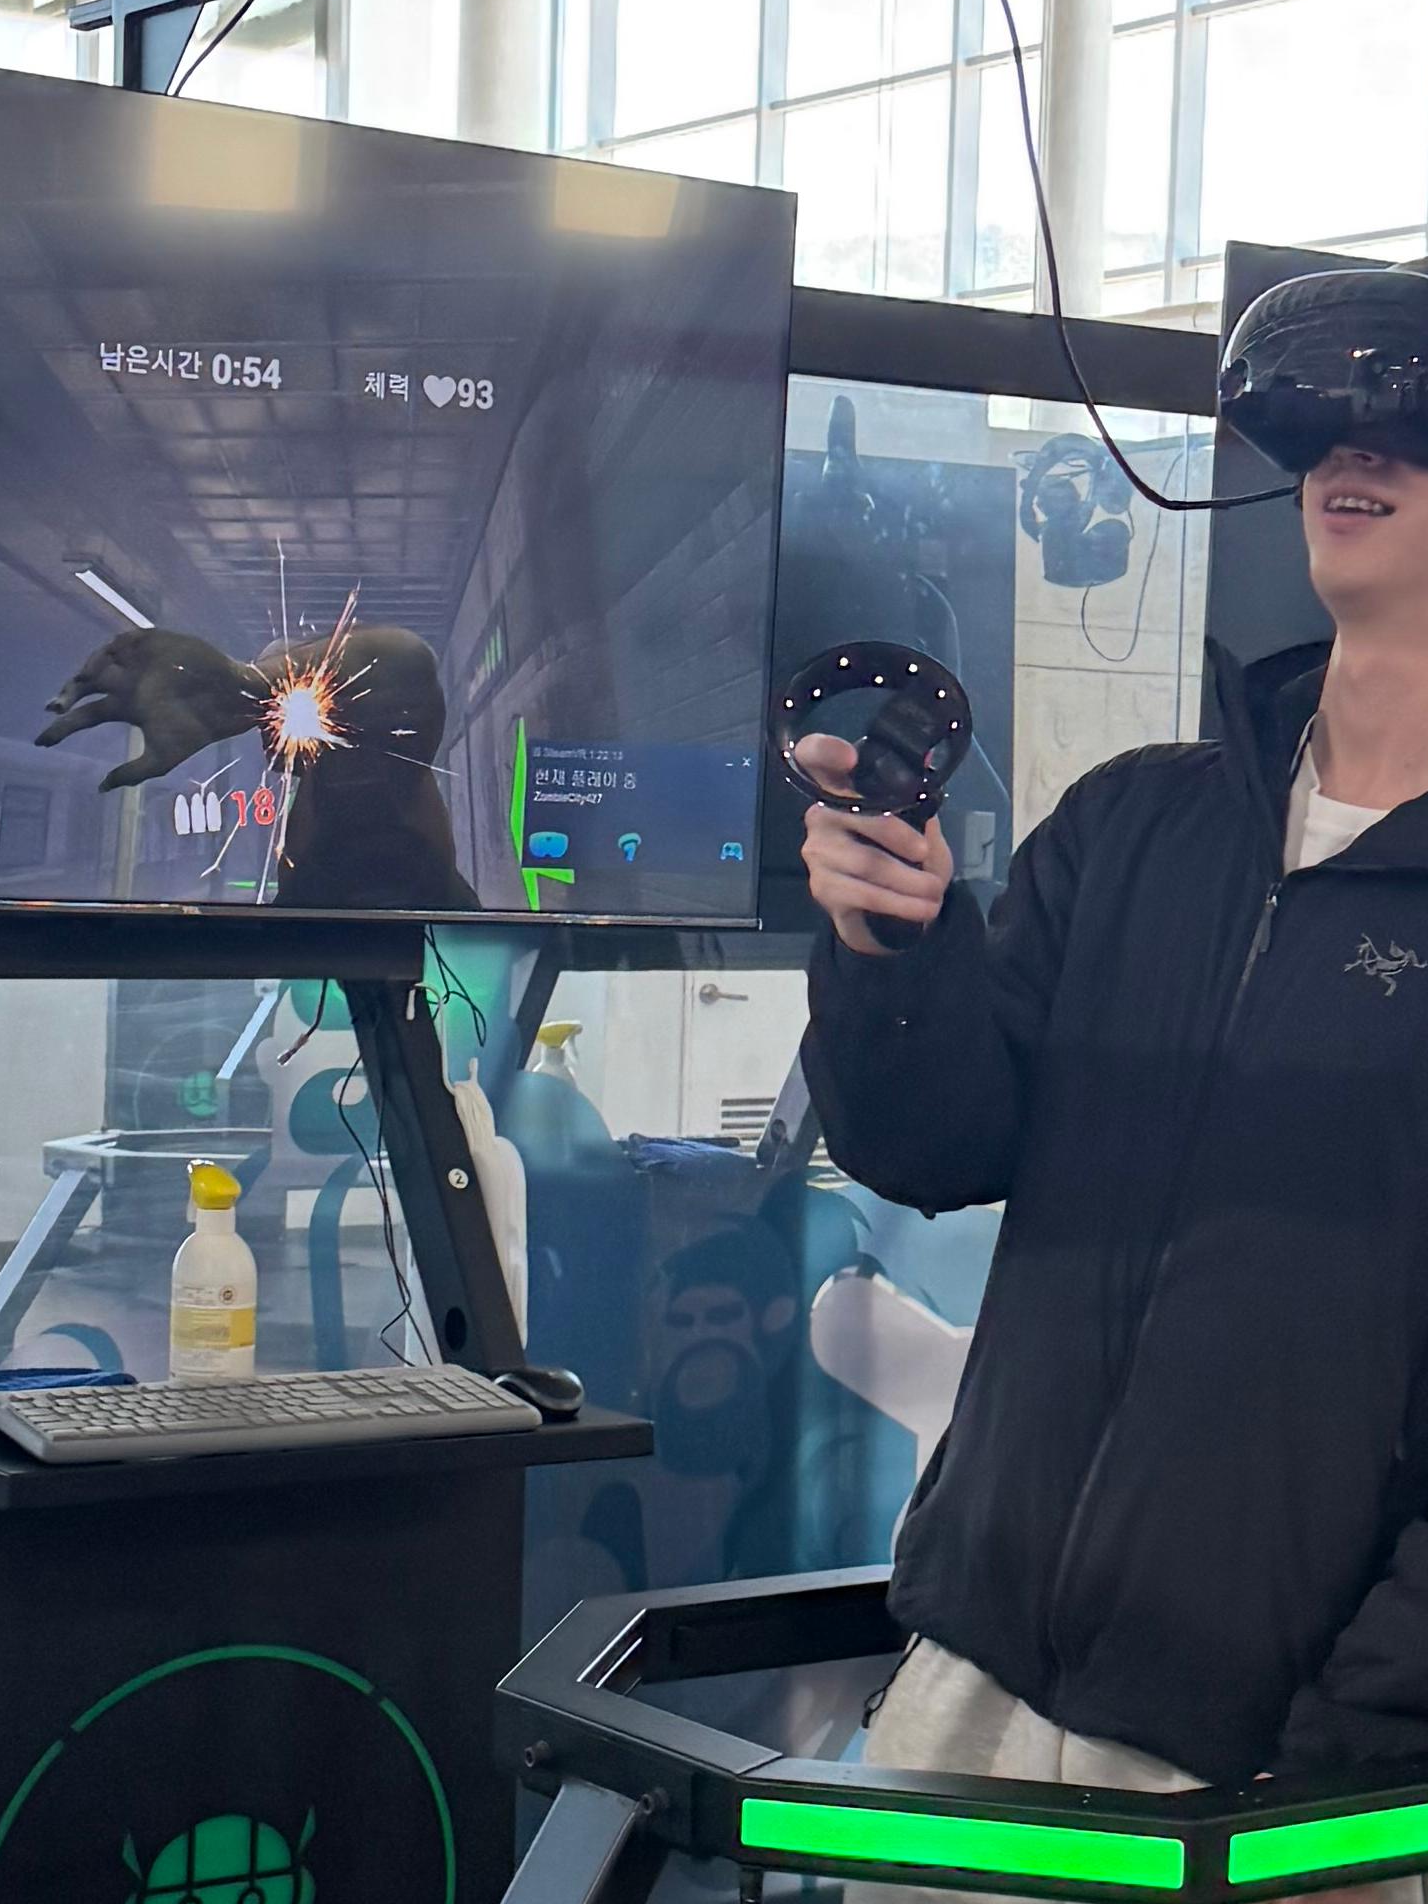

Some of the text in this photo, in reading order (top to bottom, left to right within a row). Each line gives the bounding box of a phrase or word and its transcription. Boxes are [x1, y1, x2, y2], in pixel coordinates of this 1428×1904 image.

[99, 341, 282, 390] 남은시간 0:54
[364, 371, 494, 410] 체력 93
[535, 768, 566, 786] 현재
[572, 769, 617, 789] 플레이
[229, 787, 276, 827] 18
